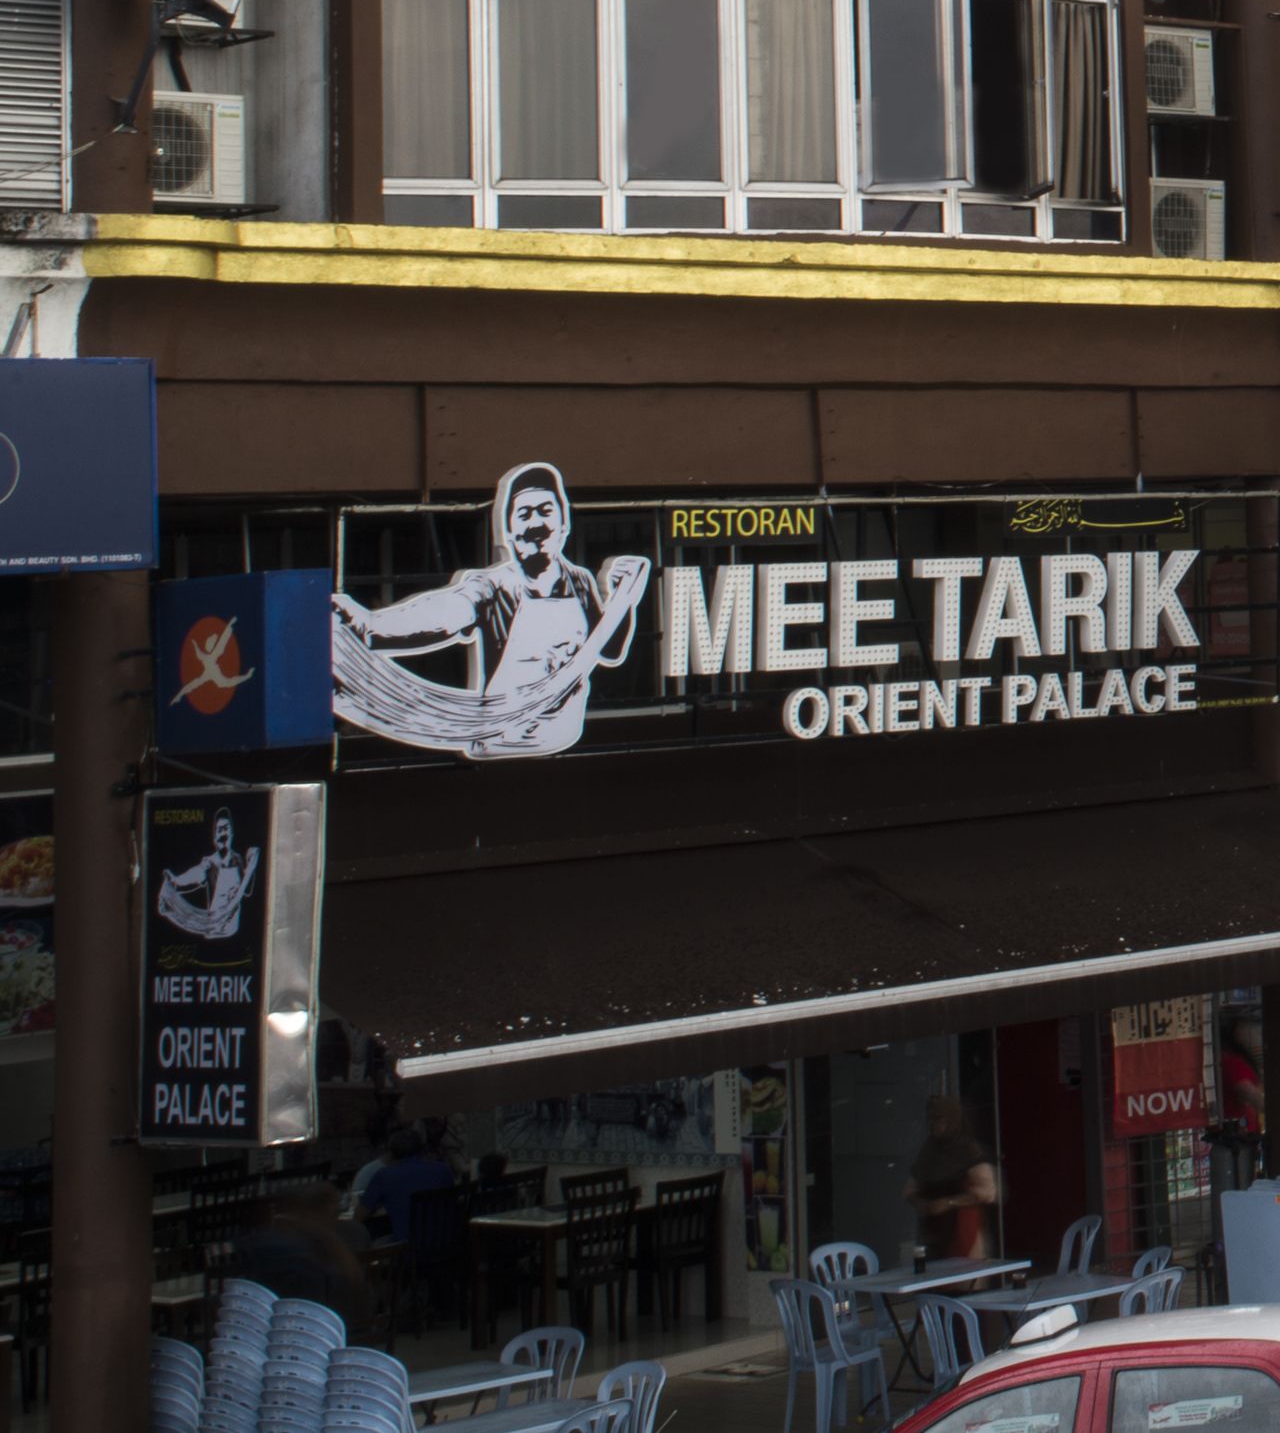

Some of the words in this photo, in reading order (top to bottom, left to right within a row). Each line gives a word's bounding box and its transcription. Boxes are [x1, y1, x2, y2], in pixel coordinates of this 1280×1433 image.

[671, 507, 815, 538] RESTORAN
[9, 557, 26, 566] AND
[28, 556, 59, 565] BEAUTY
[661, 559, 899, 677] MEE
[913, 549, 1201, 661] TARIK
[783, 676, 992, 740] ORIENT
[1002, 664, 1198, 724] PALACE
[154, 809, 204, 825] RESTORAN
[154, 975, 193, 1004] MEE
[197, 974, 252, 1004] TARIK
[158, 1026, 246, 1069] ORIENT
[154, 1082, 246, 1127] PALACE
